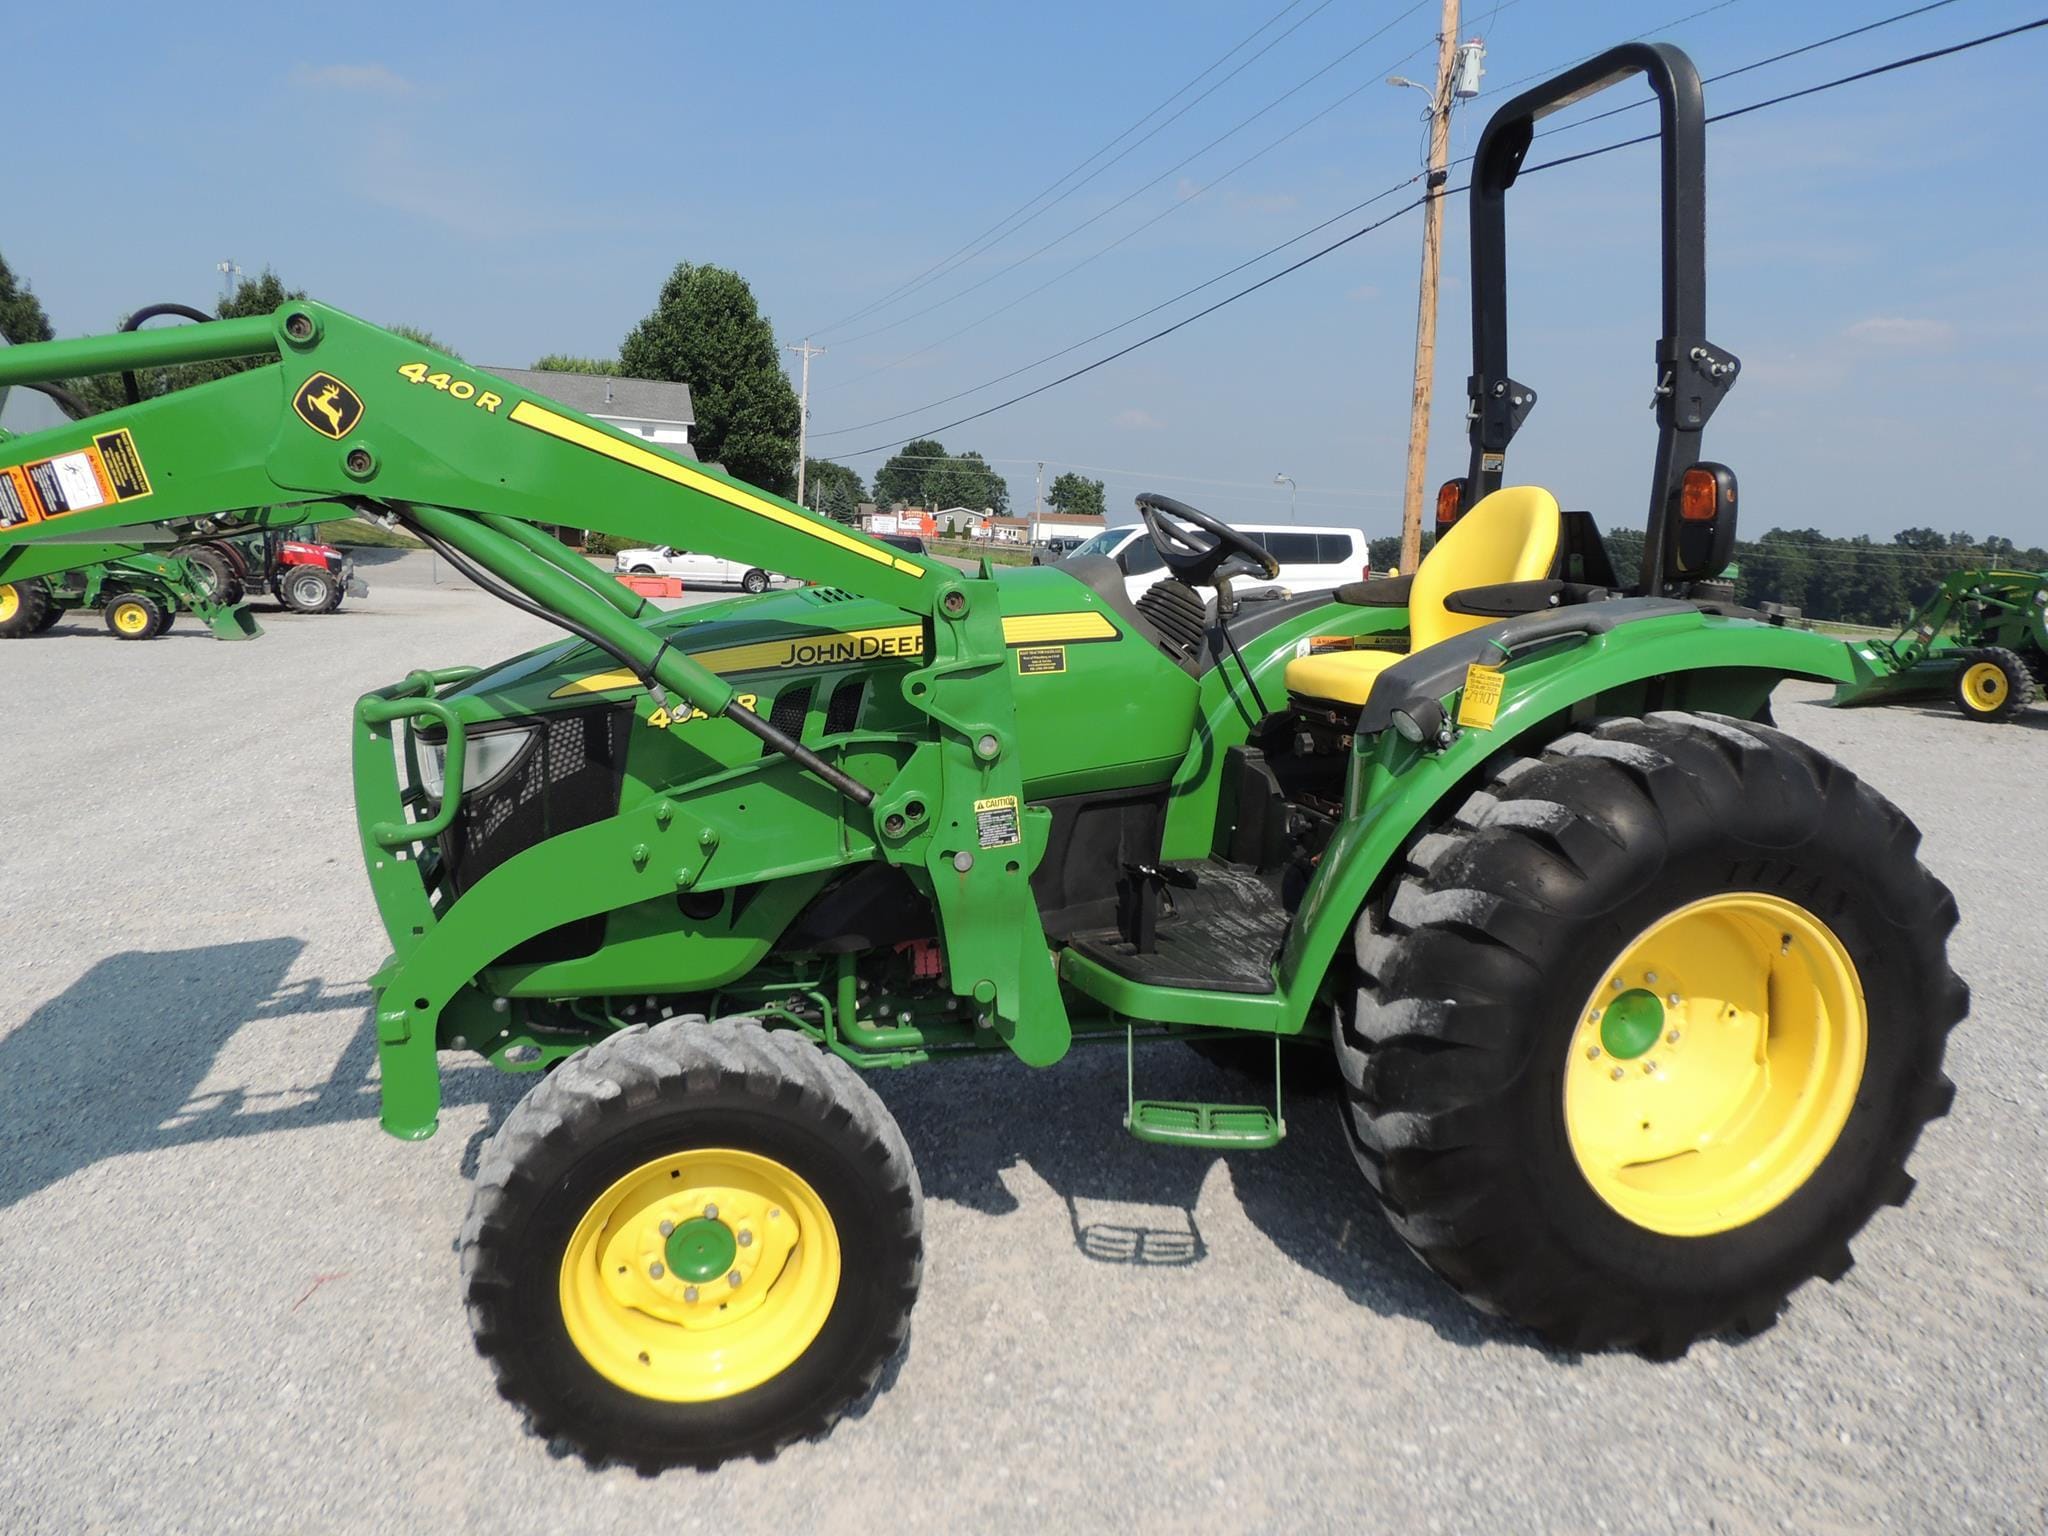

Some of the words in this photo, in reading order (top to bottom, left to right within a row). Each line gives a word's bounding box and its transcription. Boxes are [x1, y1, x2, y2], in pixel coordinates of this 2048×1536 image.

[781, 641, 855, 666] JOHN
[860, 636, 923, 658] DEER
[985, 797, 1015, 809] CAUTION
